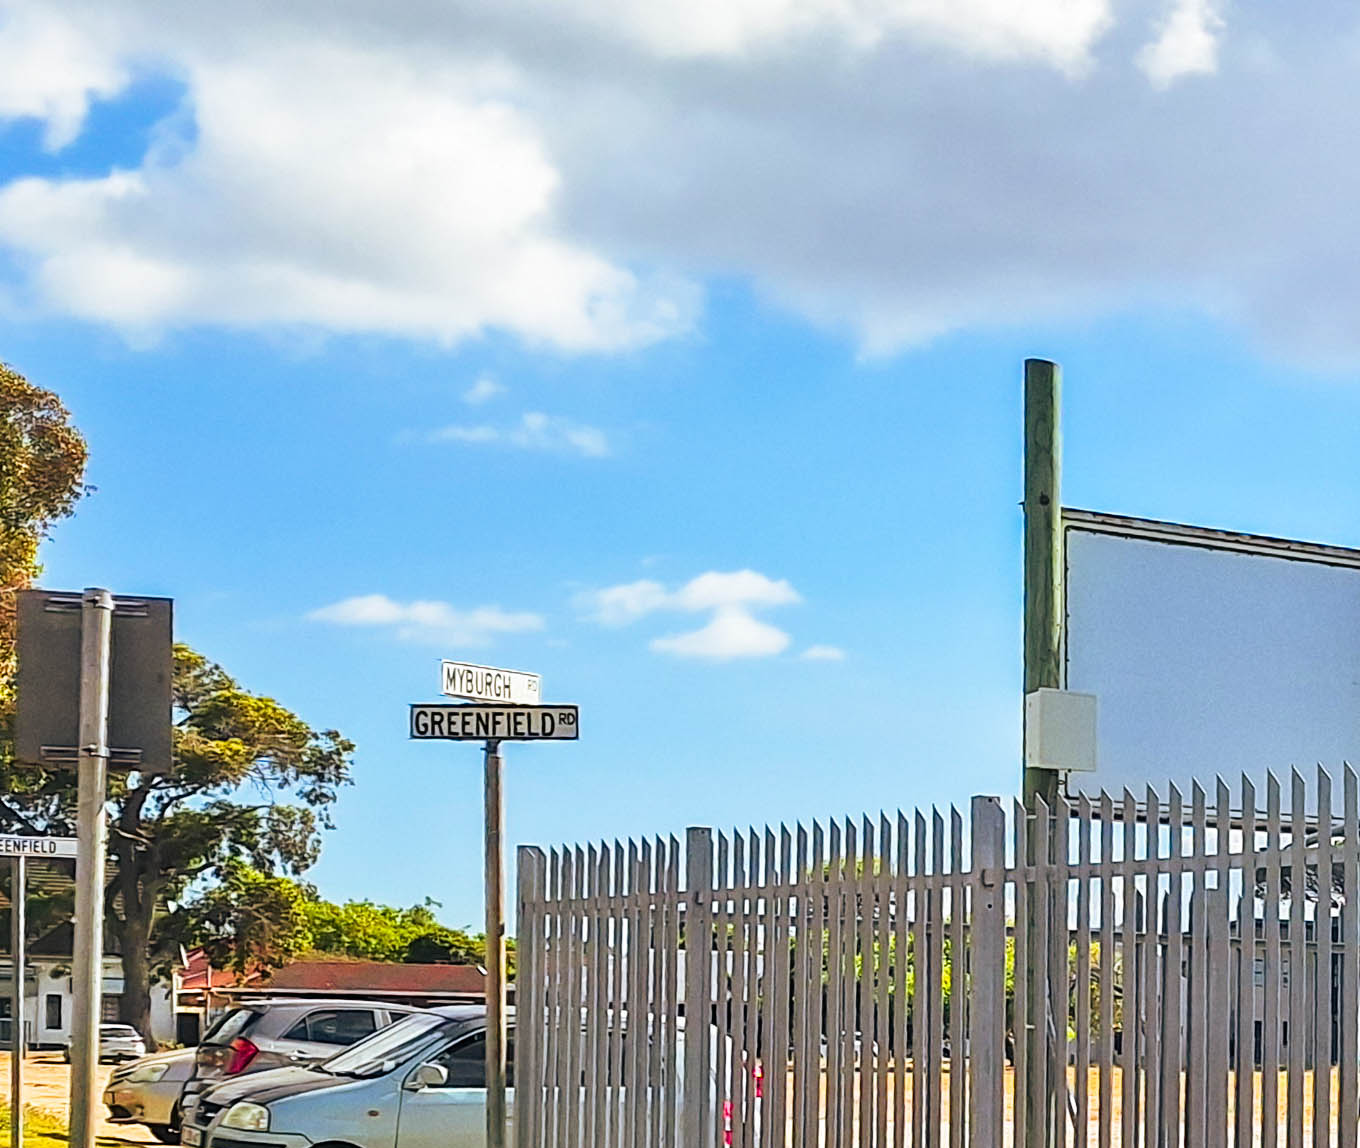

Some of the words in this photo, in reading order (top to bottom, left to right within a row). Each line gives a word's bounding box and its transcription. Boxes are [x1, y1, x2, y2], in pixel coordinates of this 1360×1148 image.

[445, 667, 512, 699] MYBURGH
[414, 710, 556, 737] GREENFIELD
[558, 712, 576, 726] RD
